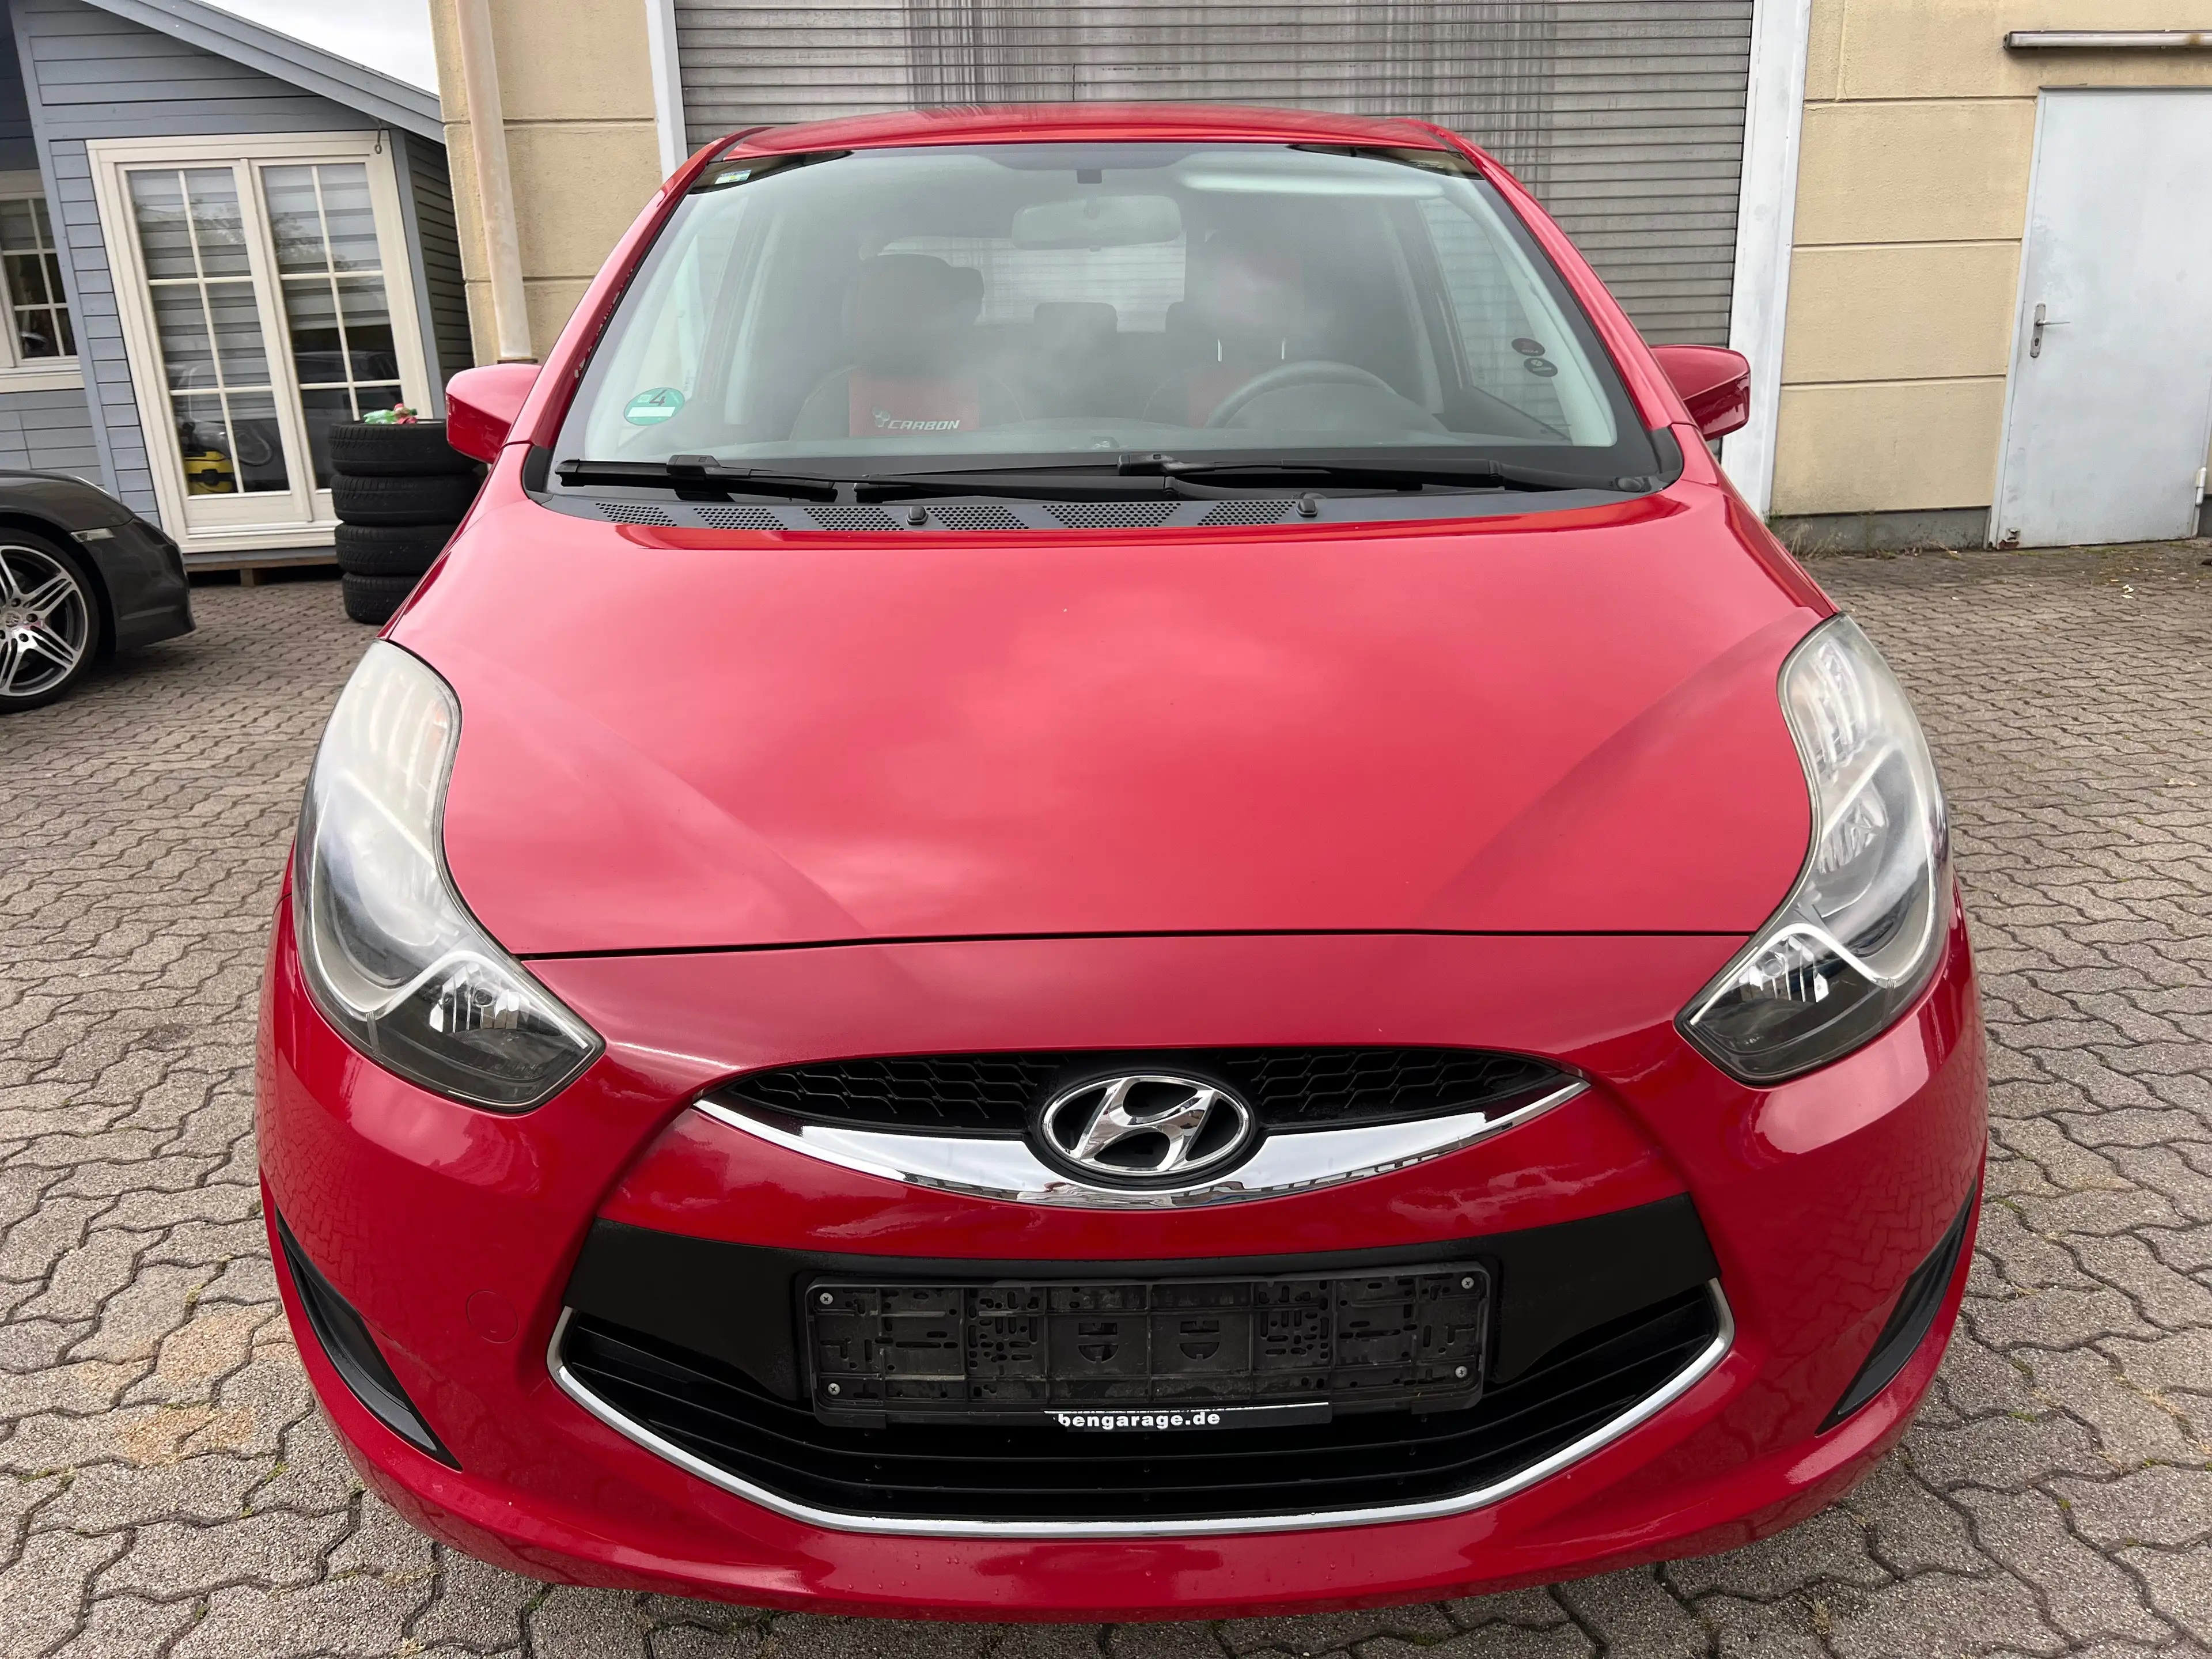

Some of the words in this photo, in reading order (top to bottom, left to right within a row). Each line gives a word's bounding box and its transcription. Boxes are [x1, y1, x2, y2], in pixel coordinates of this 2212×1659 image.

[649, 389, 668, 406] 4
[888, 419, 960, 430] CARBON
[1058, 1411, 1220, 1430] bengarage.de
